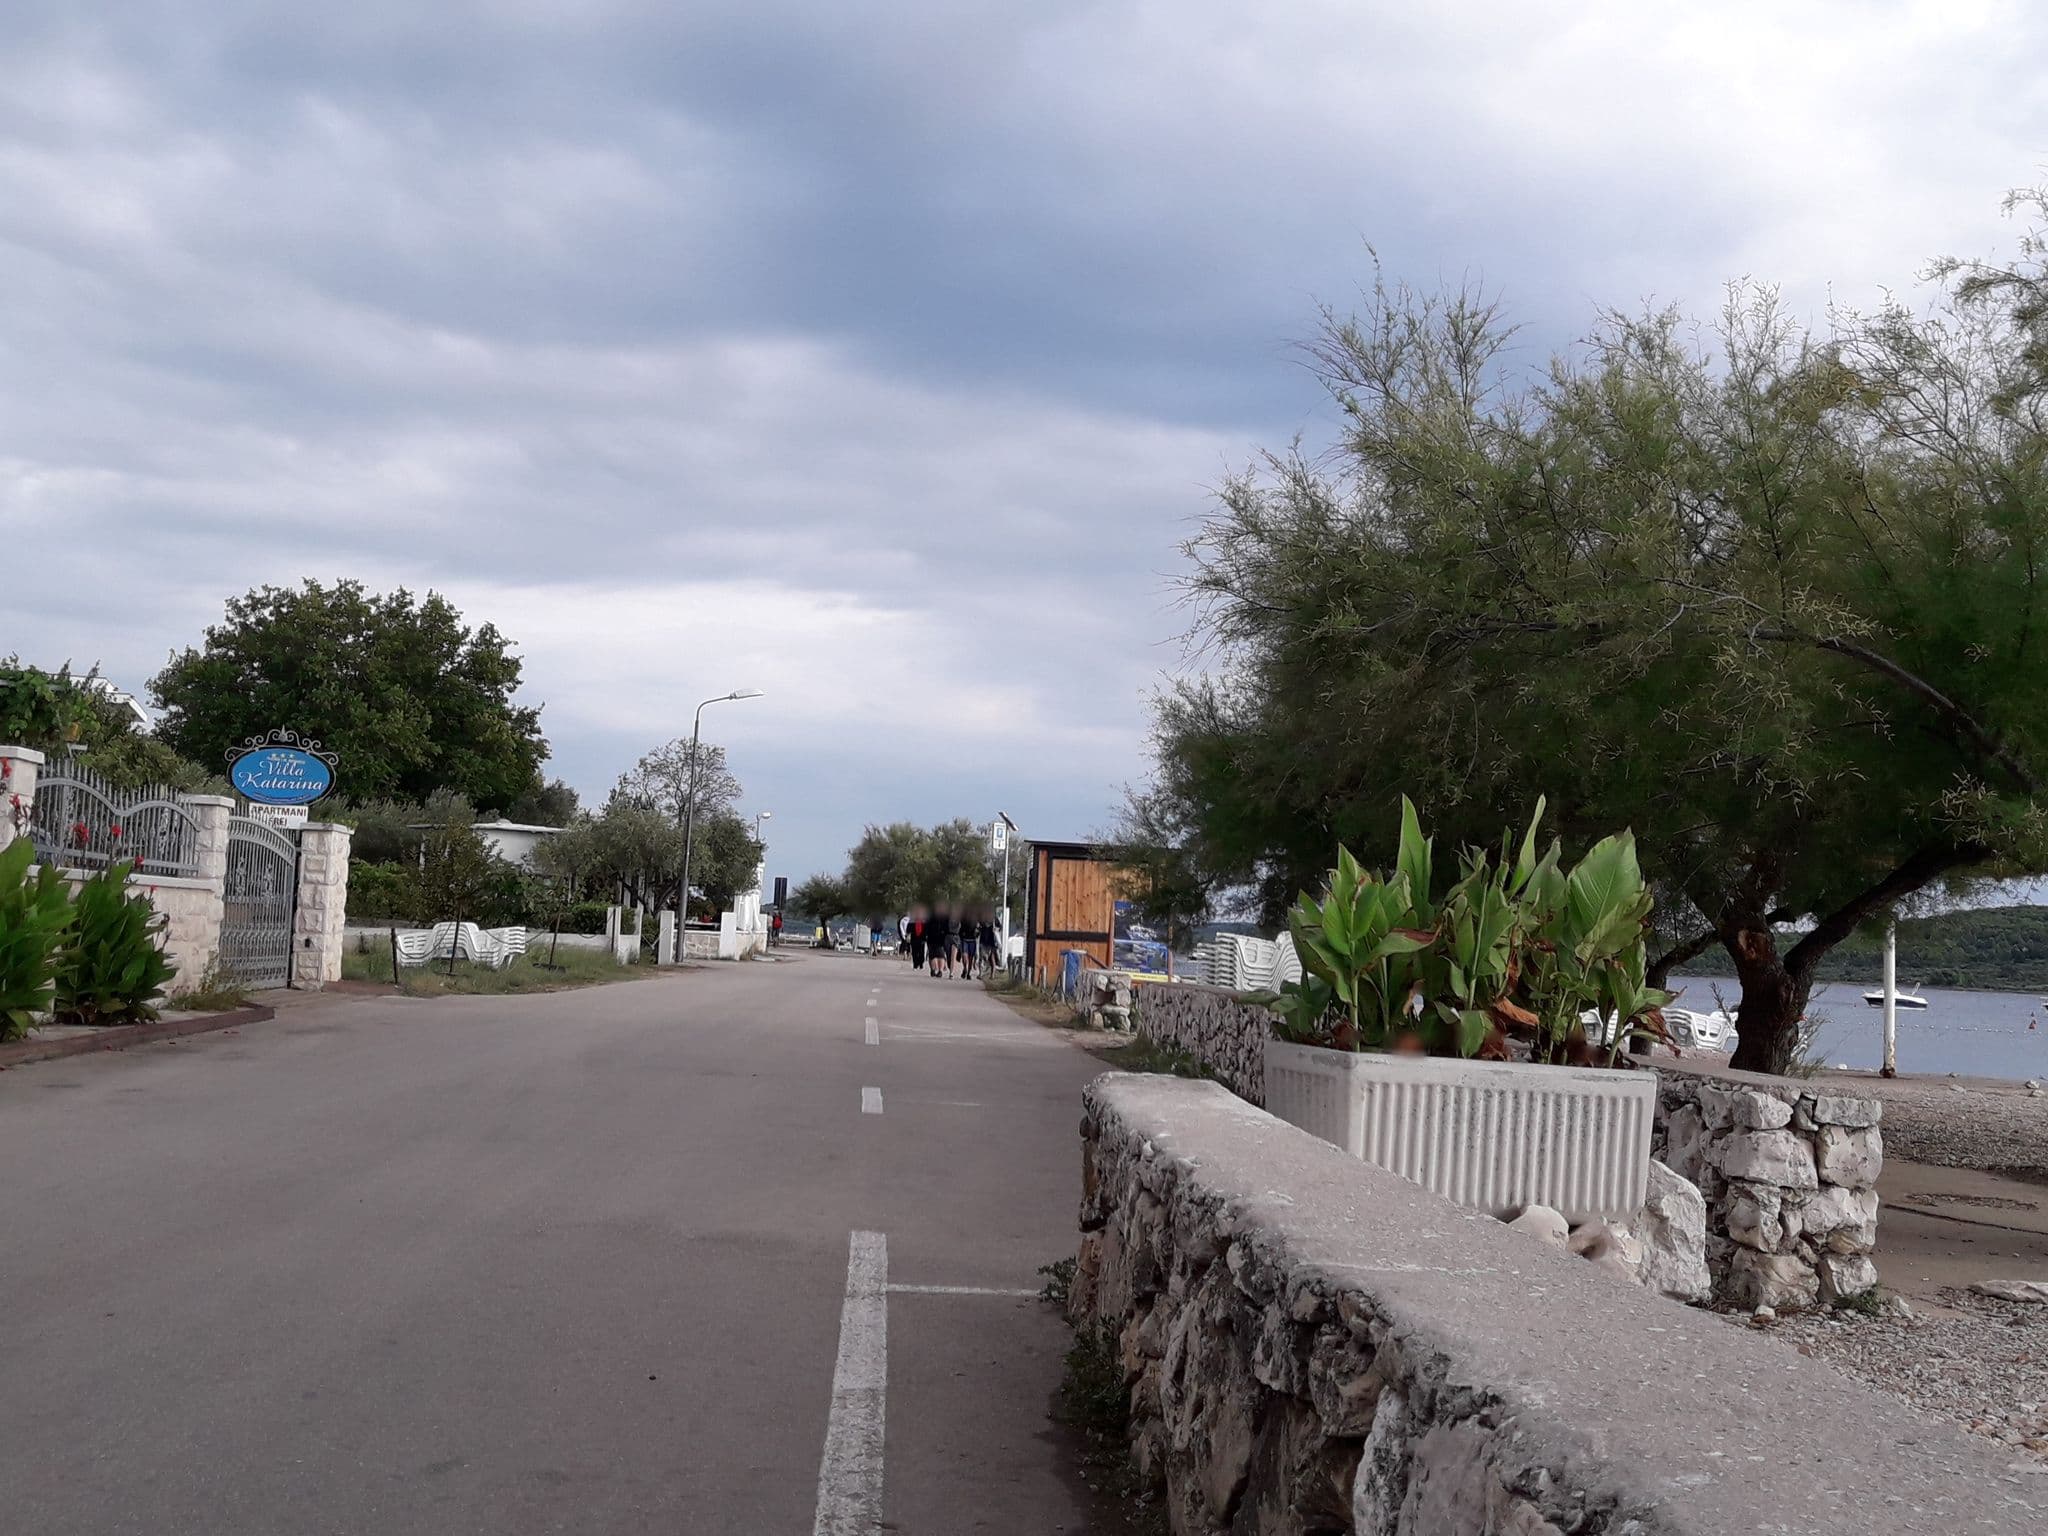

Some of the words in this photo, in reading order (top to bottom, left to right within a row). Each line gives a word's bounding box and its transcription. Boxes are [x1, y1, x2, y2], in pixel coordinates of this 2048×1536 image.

[259, 760, 305, 777] Villa
[238, 771, 324, 790] Katarina
[251, 805, 307, 817] APARTMANI
